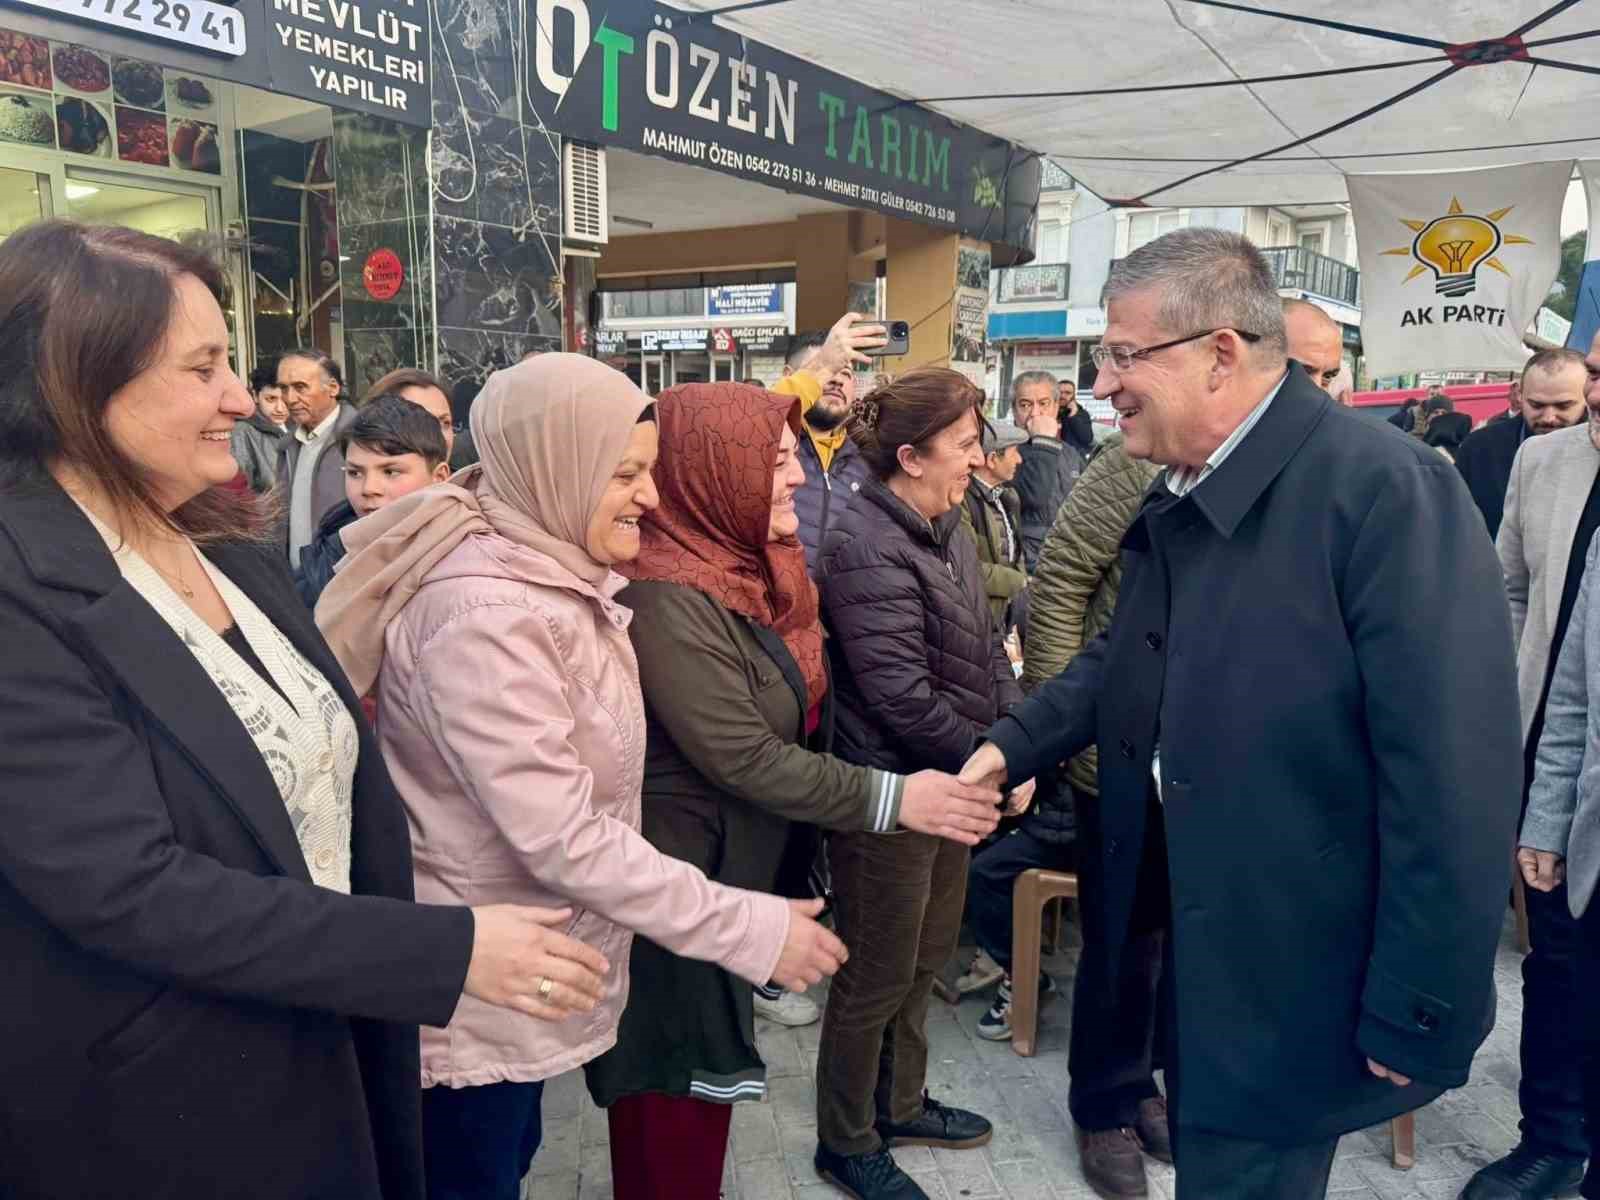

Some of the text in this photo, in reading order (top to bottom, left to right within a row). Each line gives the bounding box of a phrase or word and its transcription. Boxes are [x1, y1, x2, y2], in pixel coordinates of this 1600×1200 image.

[153, 2, 190, 32] 29
[201, 11, 235, 44] 41
[310, 65, 408, 111] YAPILIR
[646, 14, 951, 193] ÖZEN TARIM
[643, 127, 706, 160] MAHMUT
[709, 142, 743, 171] ÖZEN
[745, 155, 771, 175] 0542
[772, 161, 791, 180] 273
[792, 168, 802, 183] 51
[804, 172, 817, 188] 36
[824, 176, 860, 199] MEHMET
[880, 191, 904, 211] GÜLER
[1400, 305, 1434, 328] AK
